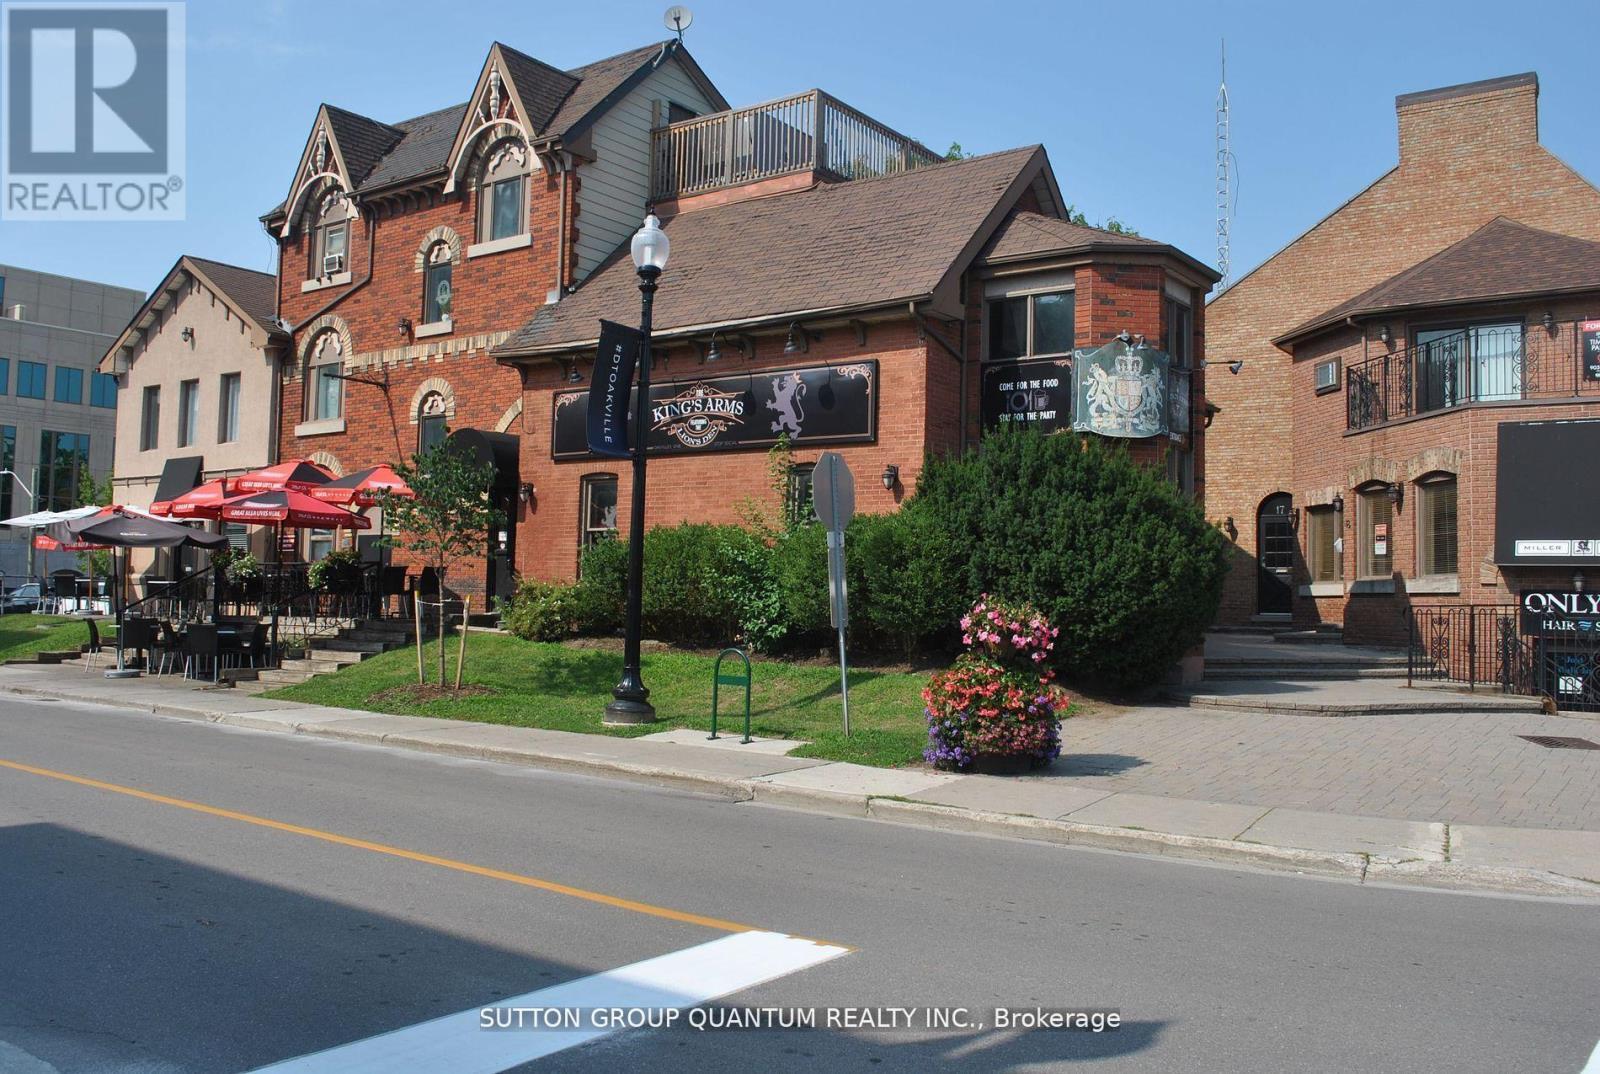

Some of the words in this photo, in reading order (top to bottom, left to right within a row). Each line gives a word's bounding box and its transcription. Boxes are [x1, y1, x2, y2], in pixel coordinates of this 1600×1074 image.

[999, 382, 1014, 391] COME
[1016, 381, 1028, 390] FOR
[1030, 380, 1041, 389] THE
[1042, 378, 1059, 388] FOOD
[603, 344, 622, 443] #DTOAKVILLE
[652, 399, 702, 422] KING'S
[704, 397, 744, 415] ARMS
[1026, 411, 1037, 420] THE
[1039, 410, 1057, 420] PARTY
[702, 425, 718, 444] DEN
[1276, 505, 1285, 515] 17
[1524, 593, 1600, 614] ONLY
[1543, 620, 1576, 631] HAIR
